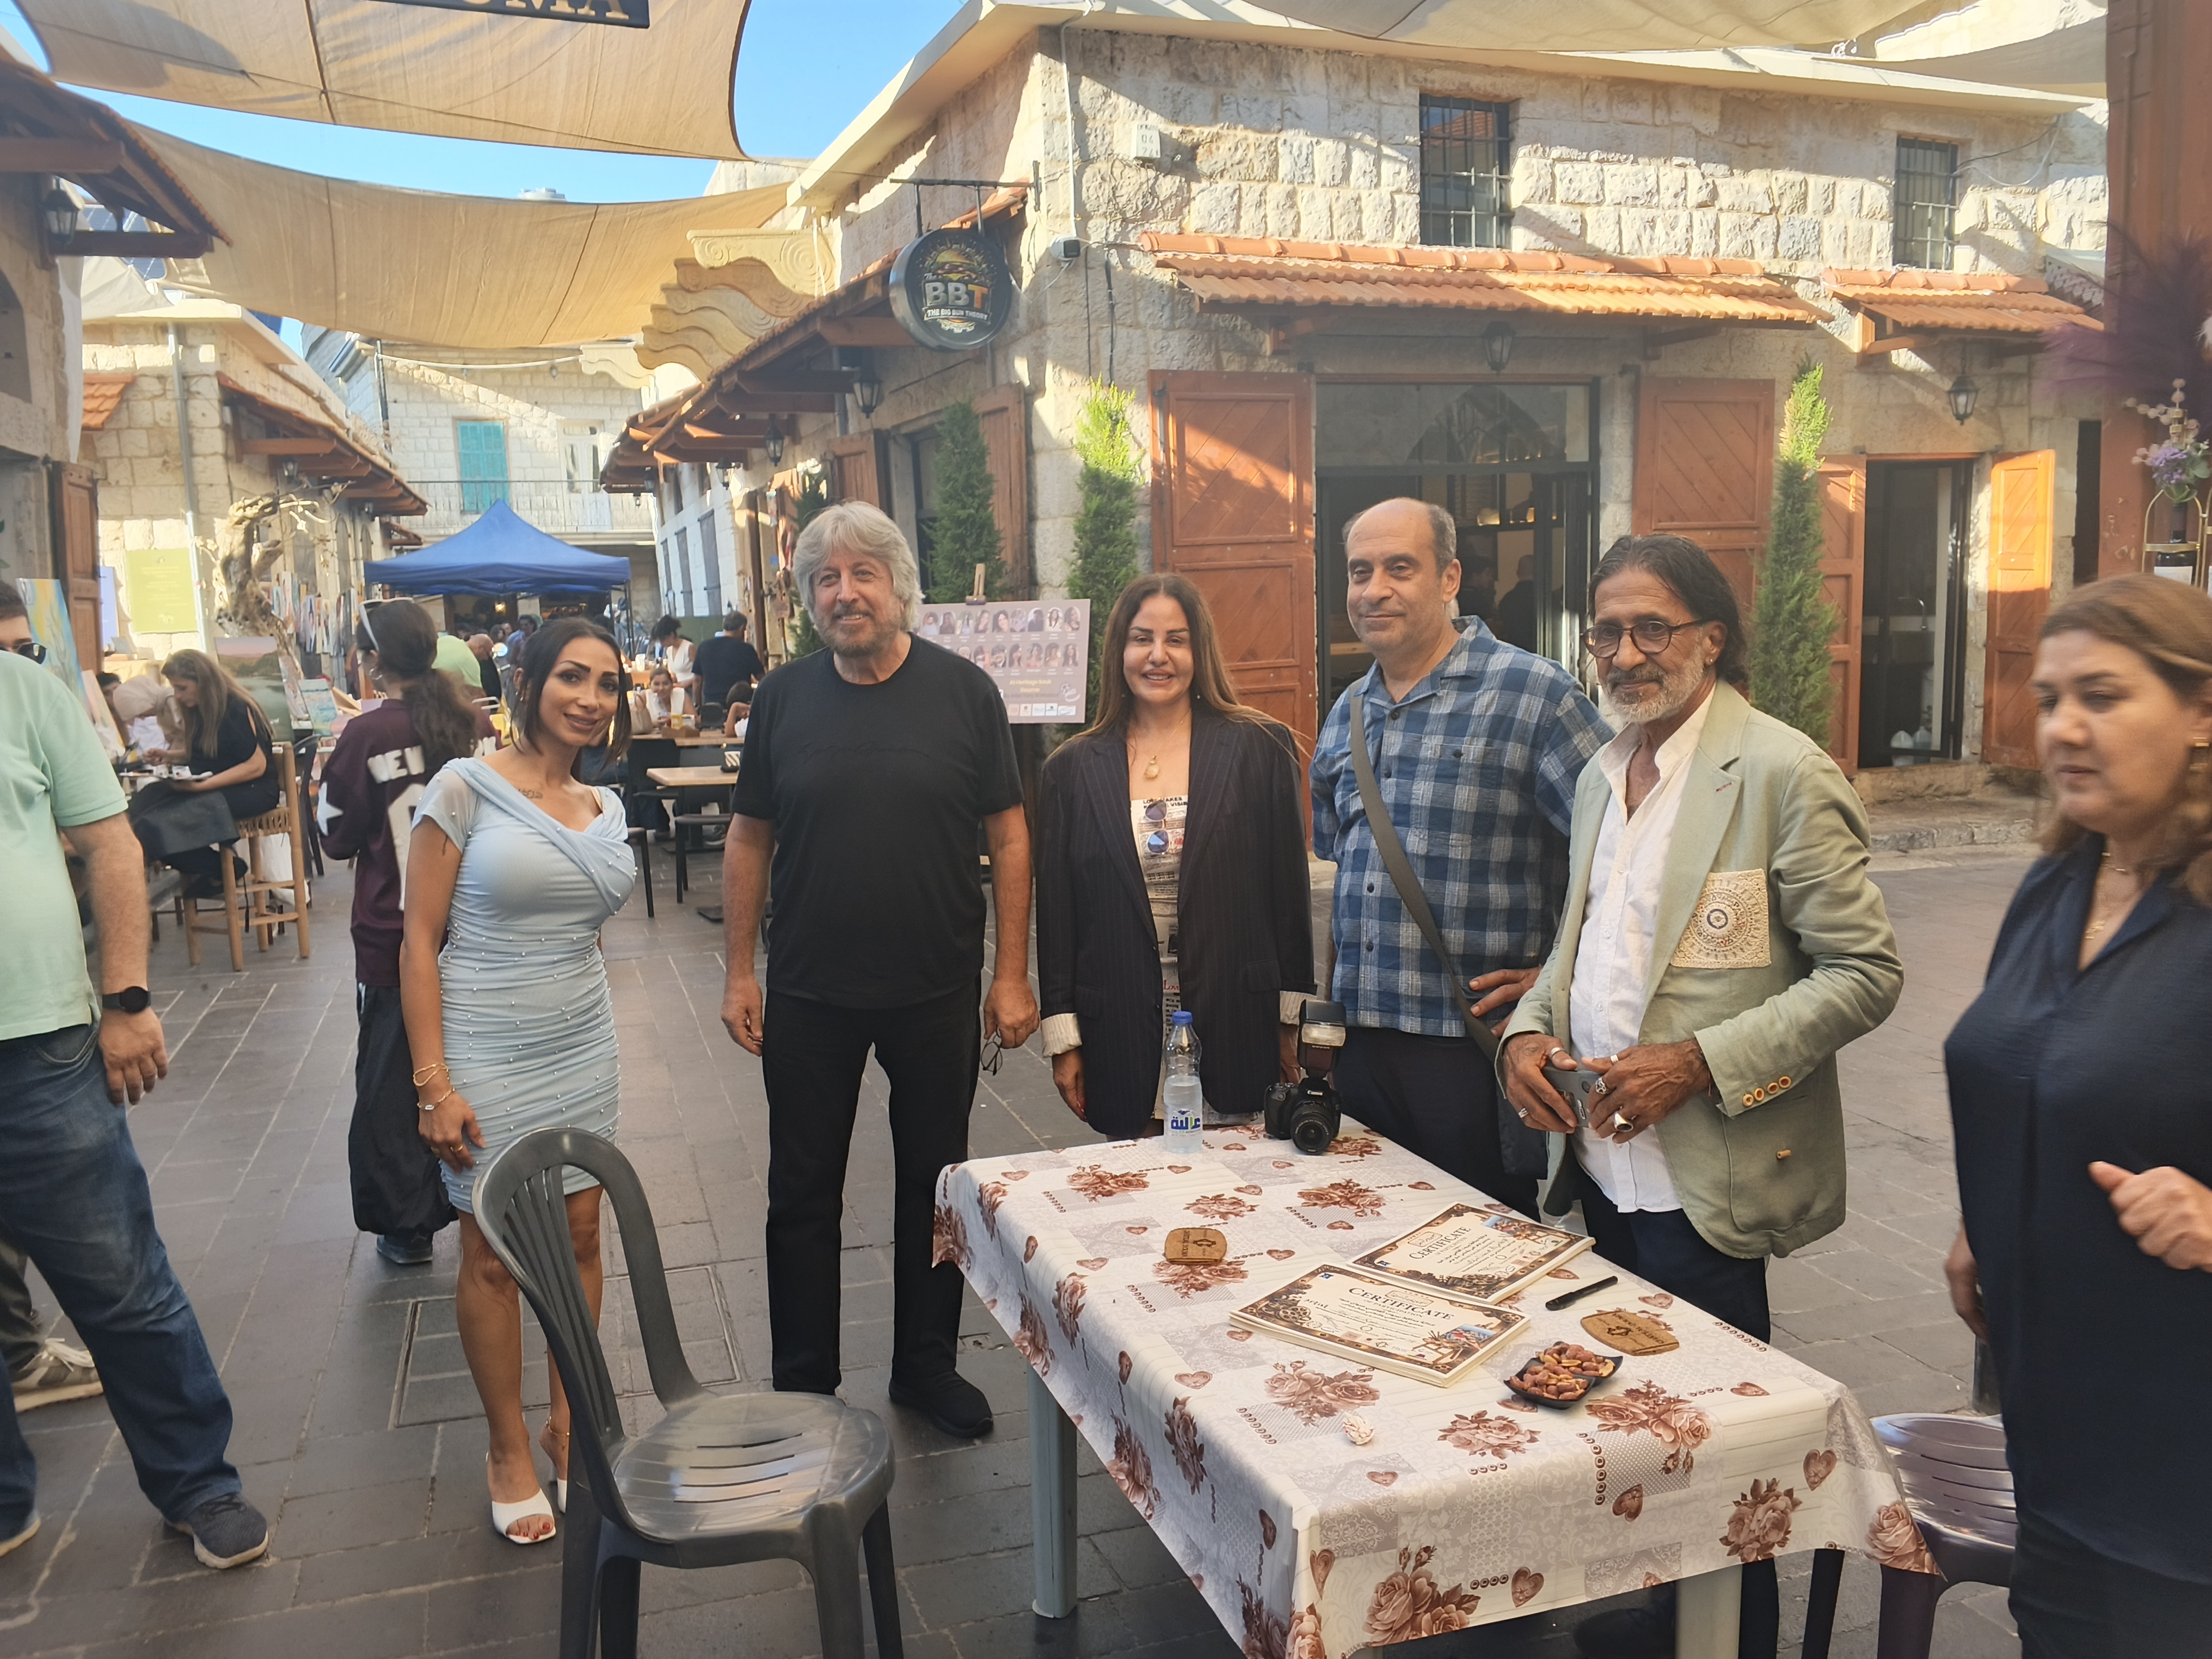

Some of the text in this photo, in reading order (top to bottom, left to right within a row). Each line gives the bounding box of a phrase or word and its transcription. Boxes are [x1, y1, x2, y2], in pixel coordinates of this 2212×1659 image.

[925, 282, 988, 309] BBT
[927, 309, 940, 317] THE
[965, 310, 988, 320] THEORY
[1409, 1226, 1470, 1259] CERTIFICATE
[1349, 1288, 1454, 1320] CERTIFICATE
